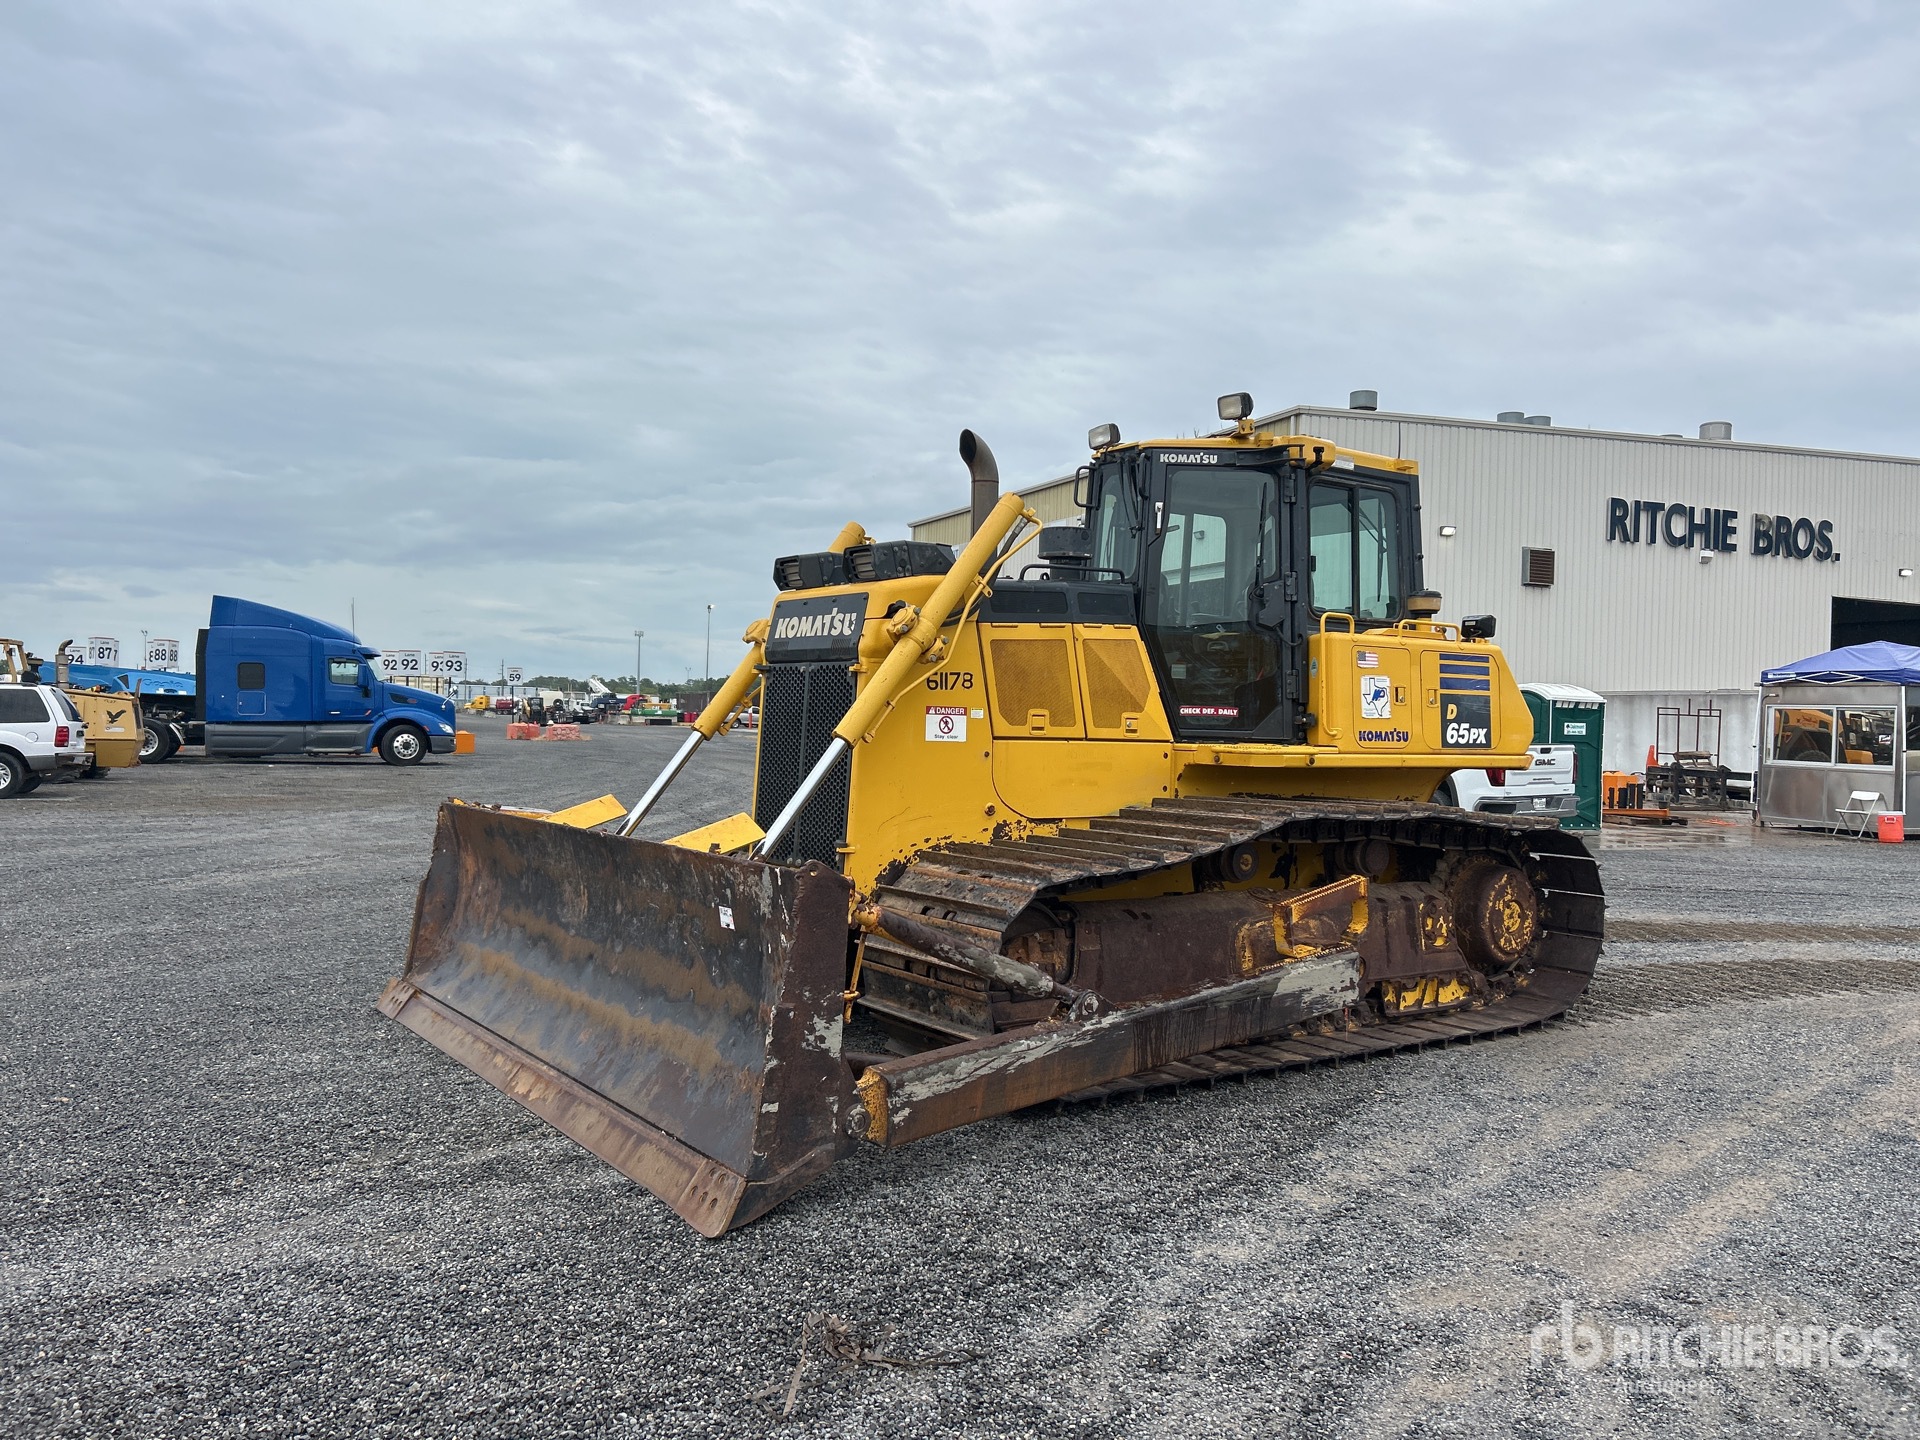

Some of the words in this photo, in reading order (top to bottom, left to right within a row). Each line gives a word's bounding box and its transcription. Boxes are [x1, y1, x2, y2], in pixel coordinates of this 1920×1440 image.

[1160, 452, 1218, 464] KOMATSU
[1606, 496, 1738, 552] RITCHIE
[1751, 512, 1841, 562] BROS.
[774, 607, 857, 639] KOMATSU
[98, 646, 112, 660] 87
[154, 648, 167, 661] 88
[169, 649, 178, 662] 88
[383, 659, 397, 671] 92
[401, 658, 418, 671] 92
[445, 659, 463, 672] 93
[509, 673, 521, 682] 59
[926, 671, 974, 691] 61178
[936, 706, 965, 715] DANGER
[1180, 707, 1201, 715] CHECK
[1218, 708, 1238, 716] DAILY
[1446, 703, 1458, 720] D
[1358, 727, 1409, 743] KOMATSU
[1446, 722, 1488, 745] 65PX
[1534, 758, 1556, 766] GMC
